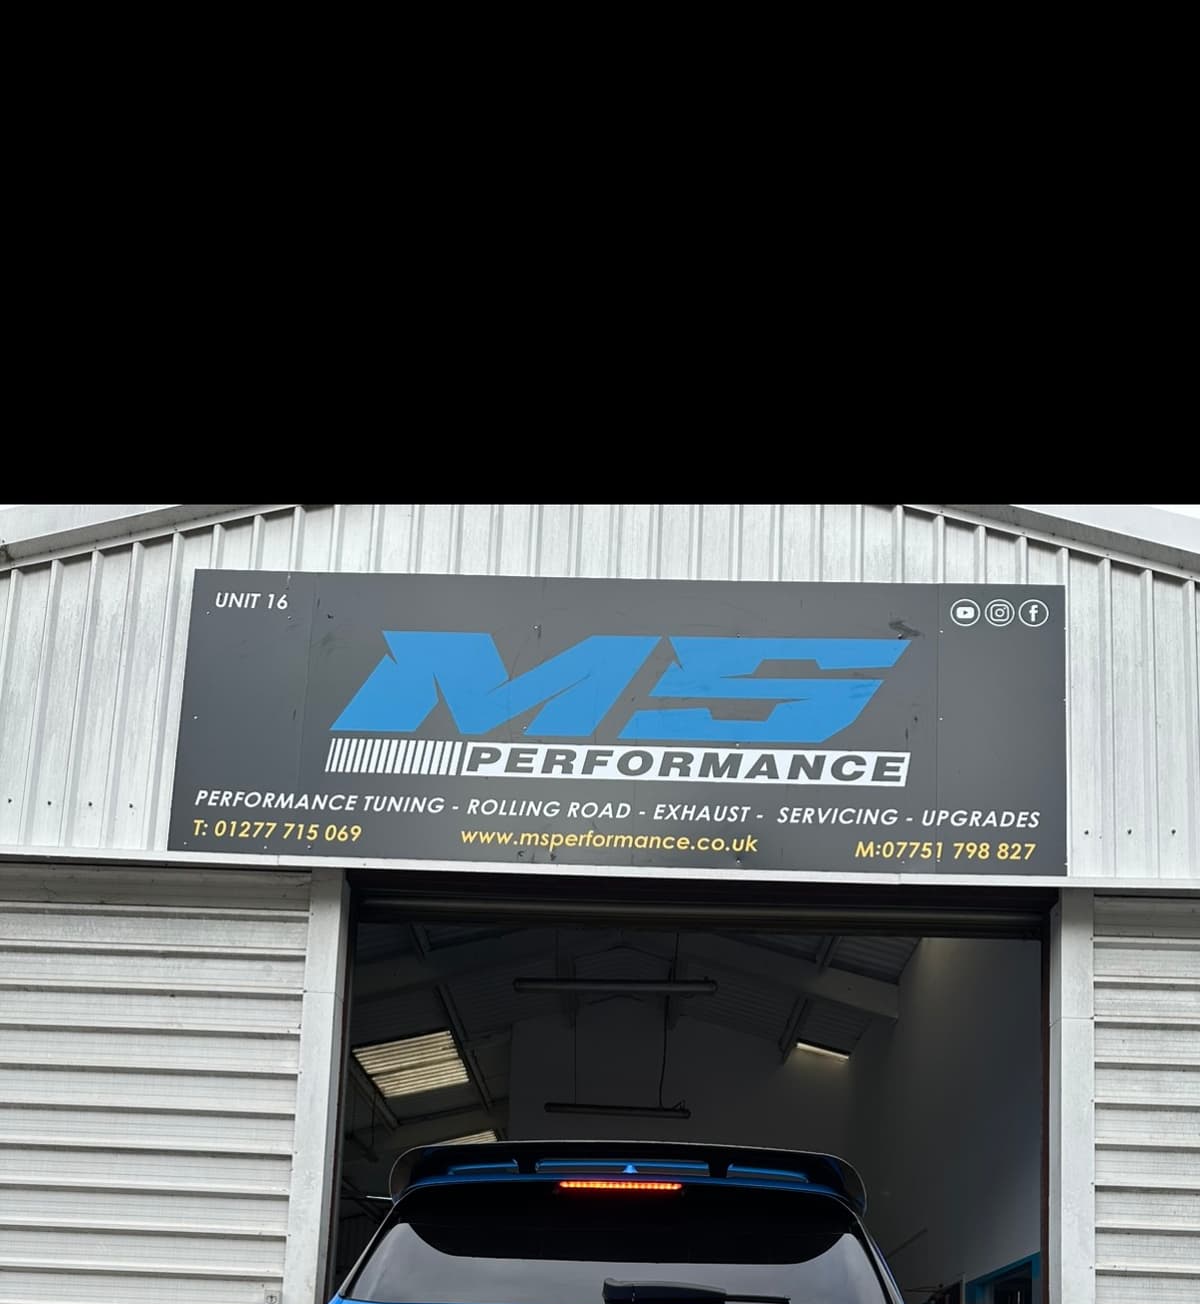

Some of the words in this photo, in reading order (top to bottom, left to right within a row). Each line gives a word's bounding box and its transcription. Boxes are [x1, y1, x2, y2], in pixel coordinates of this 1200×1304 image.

[215, 592, 260, 609] UNIT
[266, 593, 289, 610] 16
[330, 630, 912, 743] MS
[466, 746, 905, 782] PERFORMANCE
[194, 790, 357, 811] PERFORMANCE
[363, 796, 445, 814] TUNING
[466, 799, 561, 818] ROLLING
[567, 801, 631, 820] ROAD
[653, 805, 752, 823] EXHAUST
[777, 807, 899, 826] SERVICING
[922, 810, 1041, 829] UPGRADES
[193, 820, 208, 837] T:
[213, 820, 277, 840] 01277
[282, 822, 319, 842] 715
[324, 825, 363, 843] 069
[460, 830, 758, 852] www.msperformance.co.uk
[854, 841, 944, 860] M:07751
[953, 842, 992, 861] 798
[996, 843, 1037, 861] 827
